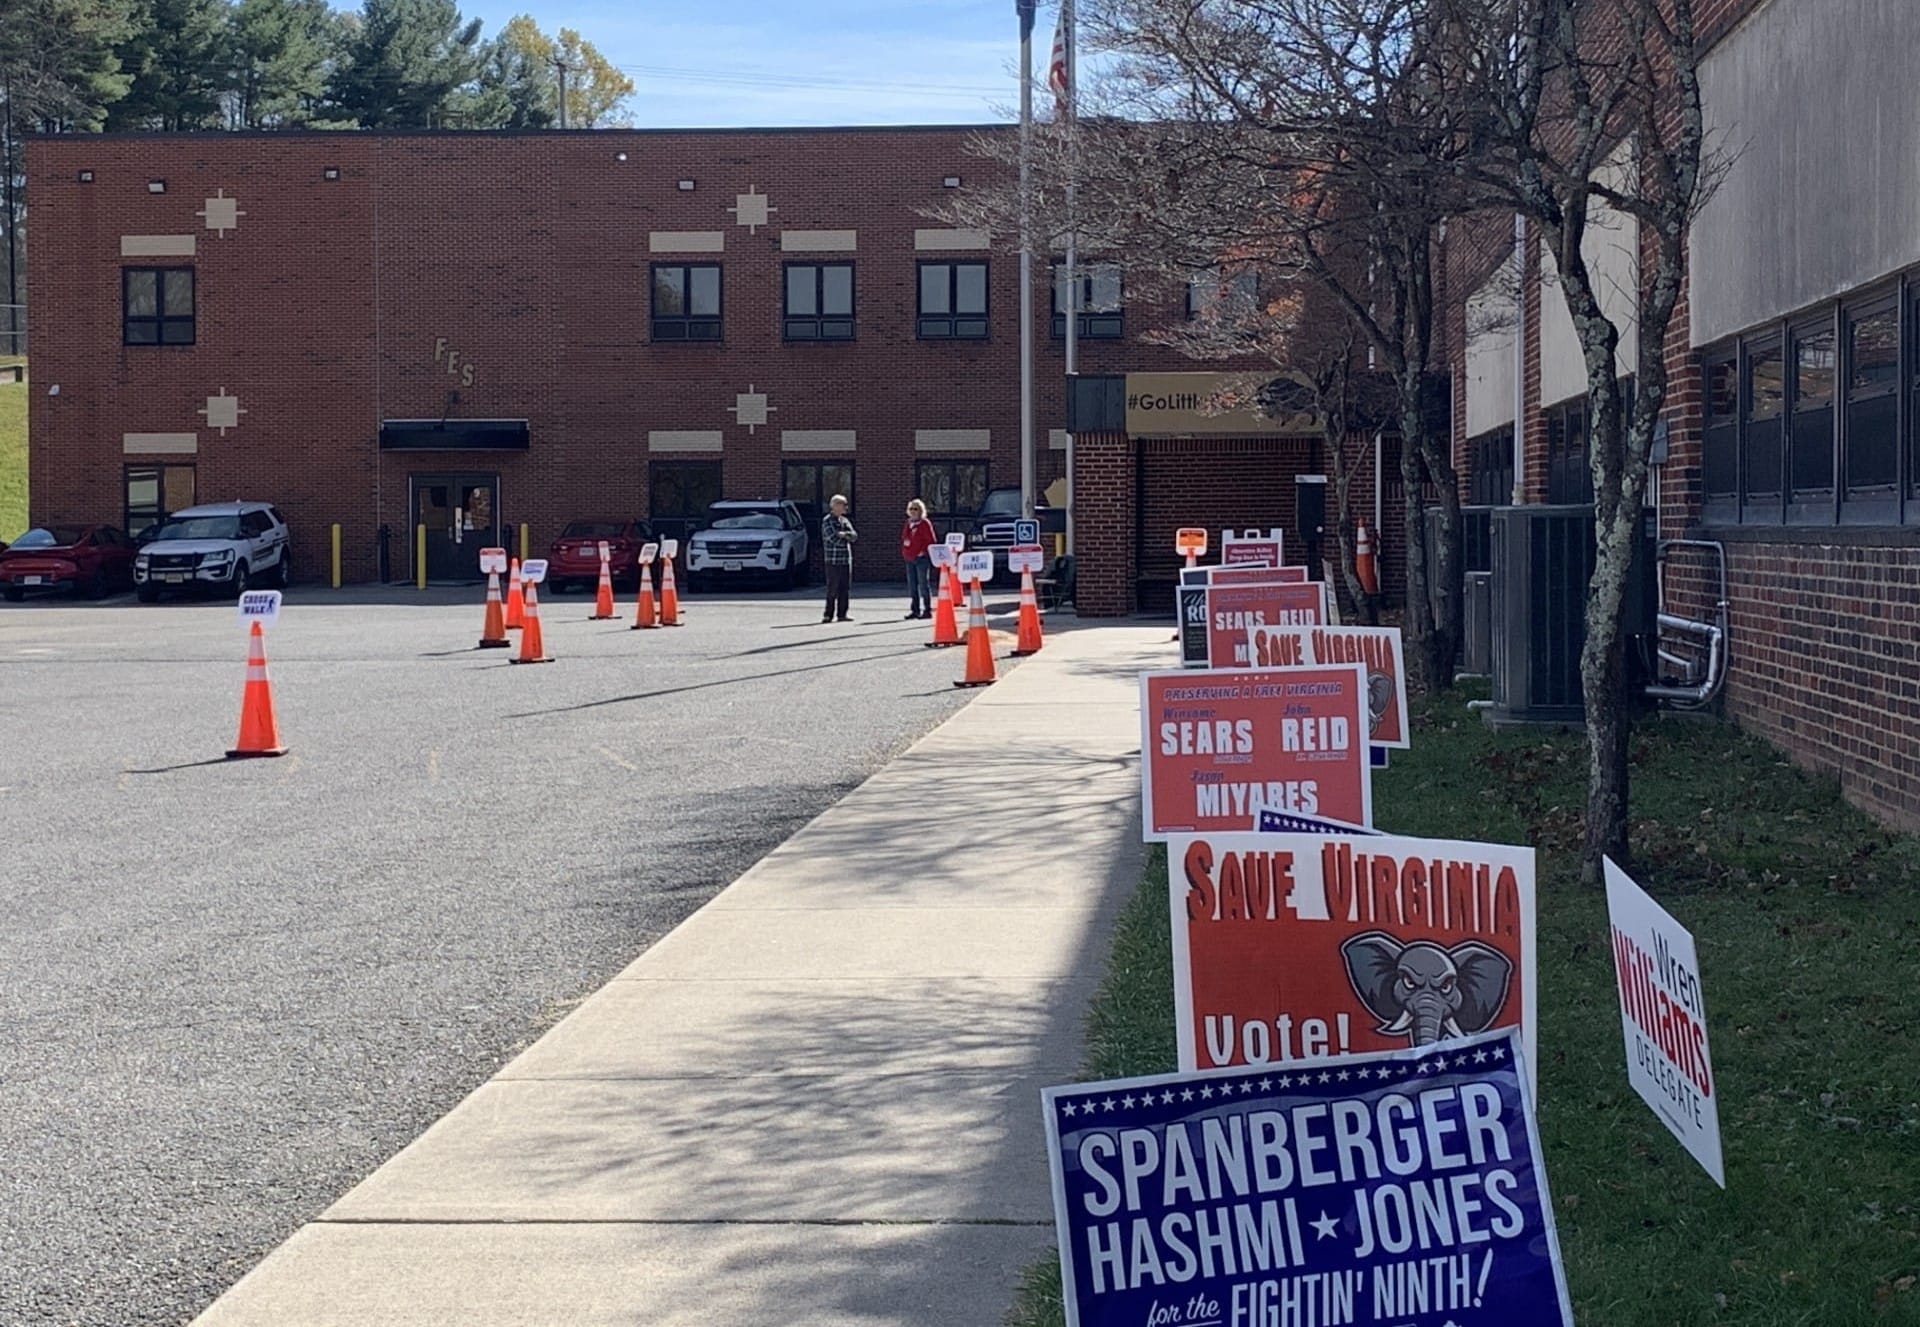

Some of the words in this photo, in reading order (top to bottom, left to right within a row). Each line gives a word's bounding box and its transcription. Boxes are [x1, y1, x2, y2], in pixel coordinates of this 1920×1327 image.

[434, 337, 474, 387] FES
[244, 606, 265, 614] WALK
[1215, 610, 1265, 631] SEARS
[1280, 608, 1315, 626] REID
[1255, 629, 1305, 667] SAVE
[1311, 629, 1395, 670] VIRGINIA
[1164, 684, 1240, 701] PRESERVING
[1242, 684, 1251, 698] A
[1254, 683, 1283, 698] FREE
[1286, 681, 1343, 697] VIRGINIA
[1160, 719, 1254, 756] SEARS
[1281, 716, 1349, 752] REID
[1196, 780, 1319, 817] MIYARES
[1184, 840, 1298, 921] SAVE
[1321, 842, 1521, 936] VIRGINIA
[1651, 927, 1702, 1019] Wren
[1612, 923, 1711, 1098] Williams
[1204, 1012, 1350, 1067] Vote!
[1635, 1034, 1704, 1130] DELEGATE
[1078, 1081, 1512, 1217] SPANBERGER
[1087, 1198, 1305, 1295] HASHMI
[1354, 1169, 1525, 1259] JONES
[1146, 1299, 1182, 1327] for
[1185, 1292, 1221, 1319] the
[1231, 1269, 1364, 1327] FIGHTIN'
[1373, 1247, 1494, 1320] NINTH!
